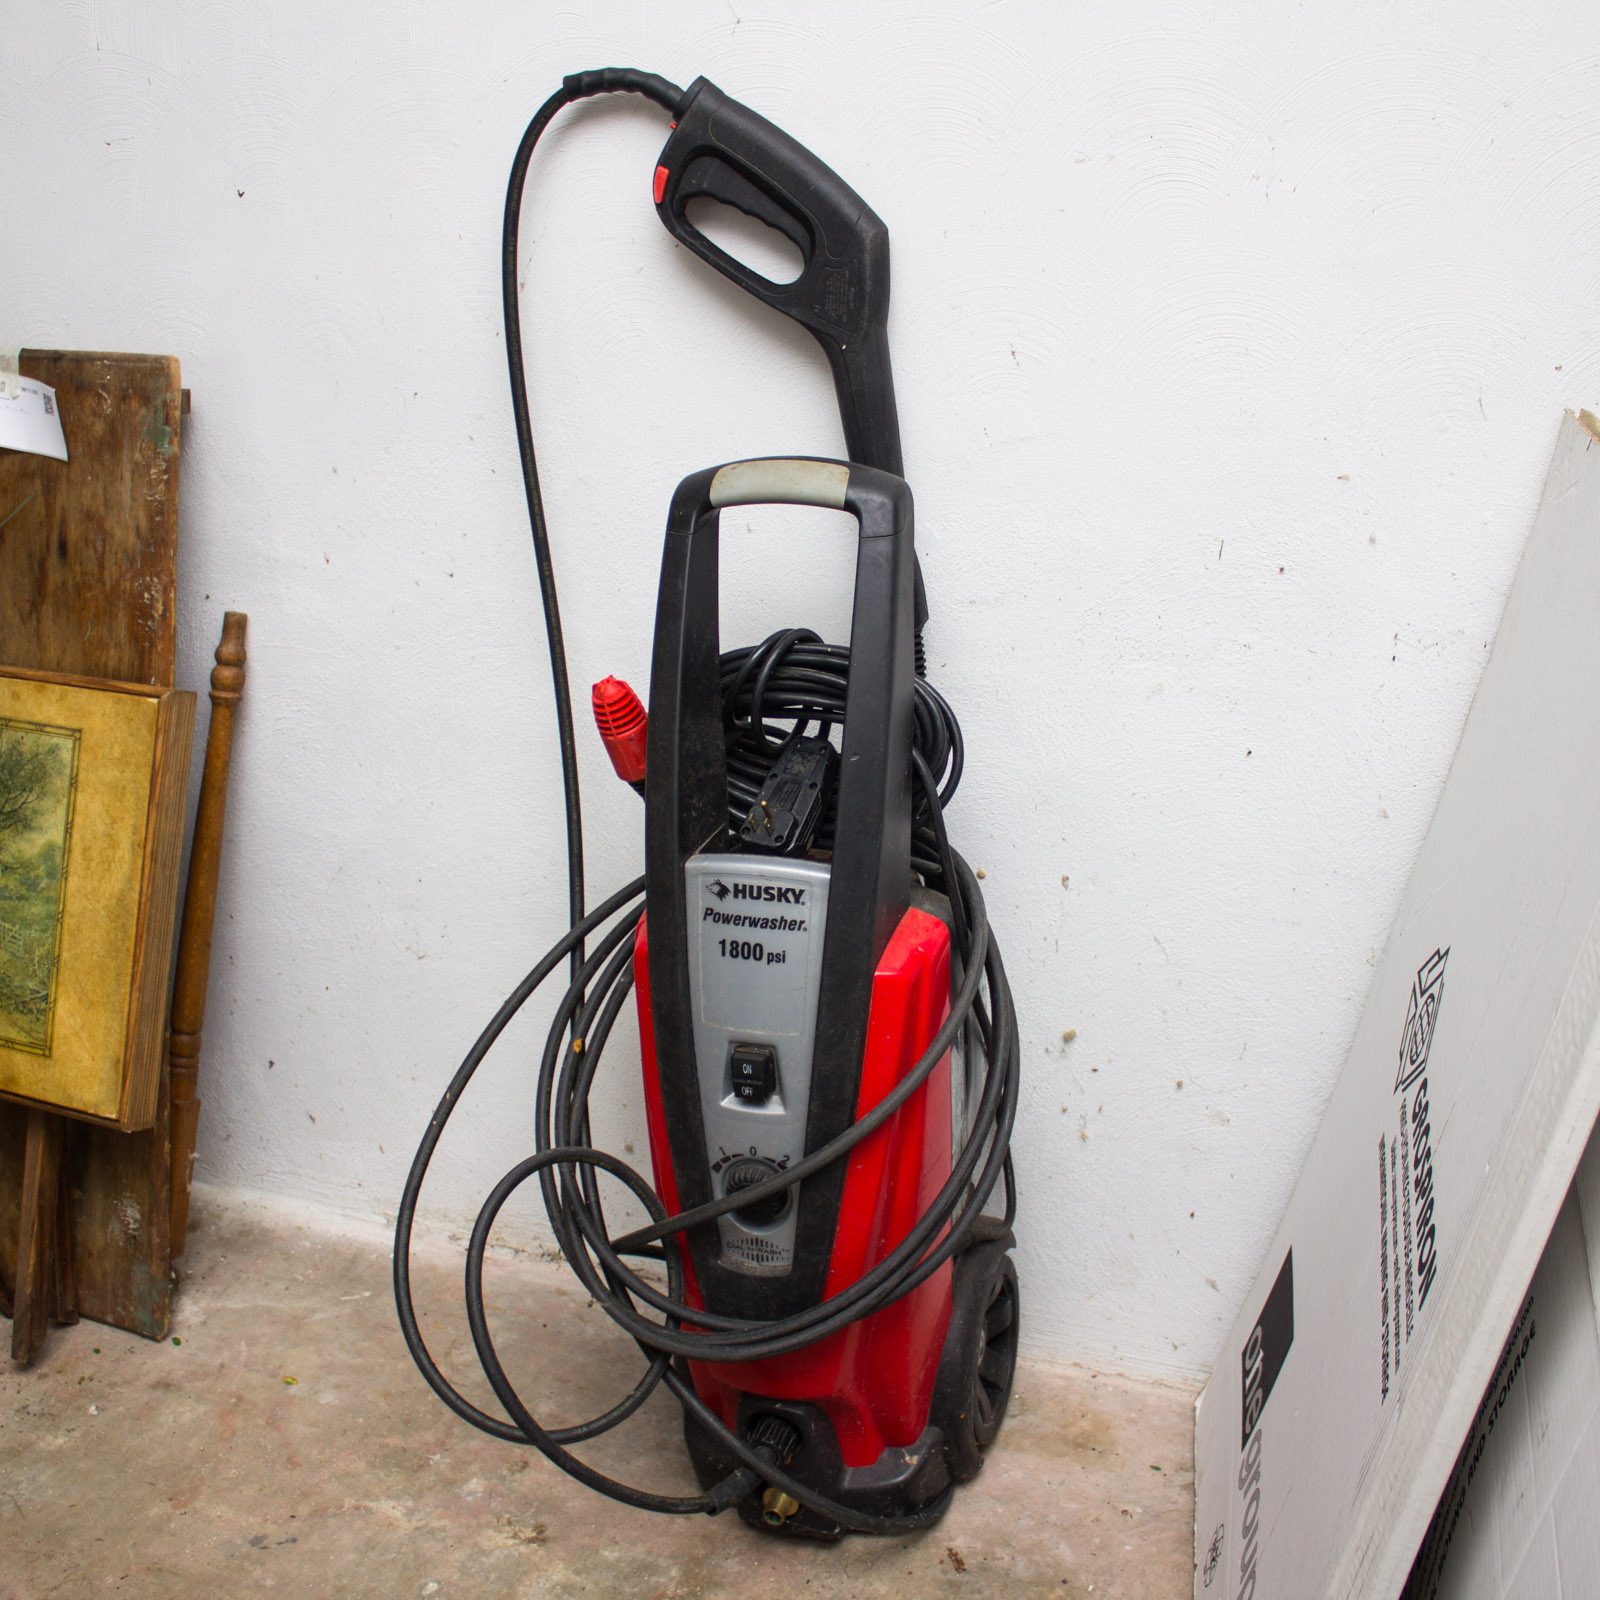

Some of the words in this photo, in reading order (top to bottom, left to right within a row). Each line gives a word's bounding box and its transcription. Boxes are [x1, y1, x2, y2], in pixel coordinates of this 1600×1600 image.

[733, 883, 805, 905] HUSKY
[703, 907, 806, 931] Powerwasher
[718, 939, 764, 961] 1800
[766, 950, 786, 965] psi
[742, 1063, 752, 1075] ON
[741, 1086, 753, 1096] OFF
[782, 1154, 791, 1165] 2
[1412, 1077, 1437, 1312] GROSPIRON
[1468, 1433, 1486, 1486] AND
[1488, 1319, 1536, 1434] STORAGE
